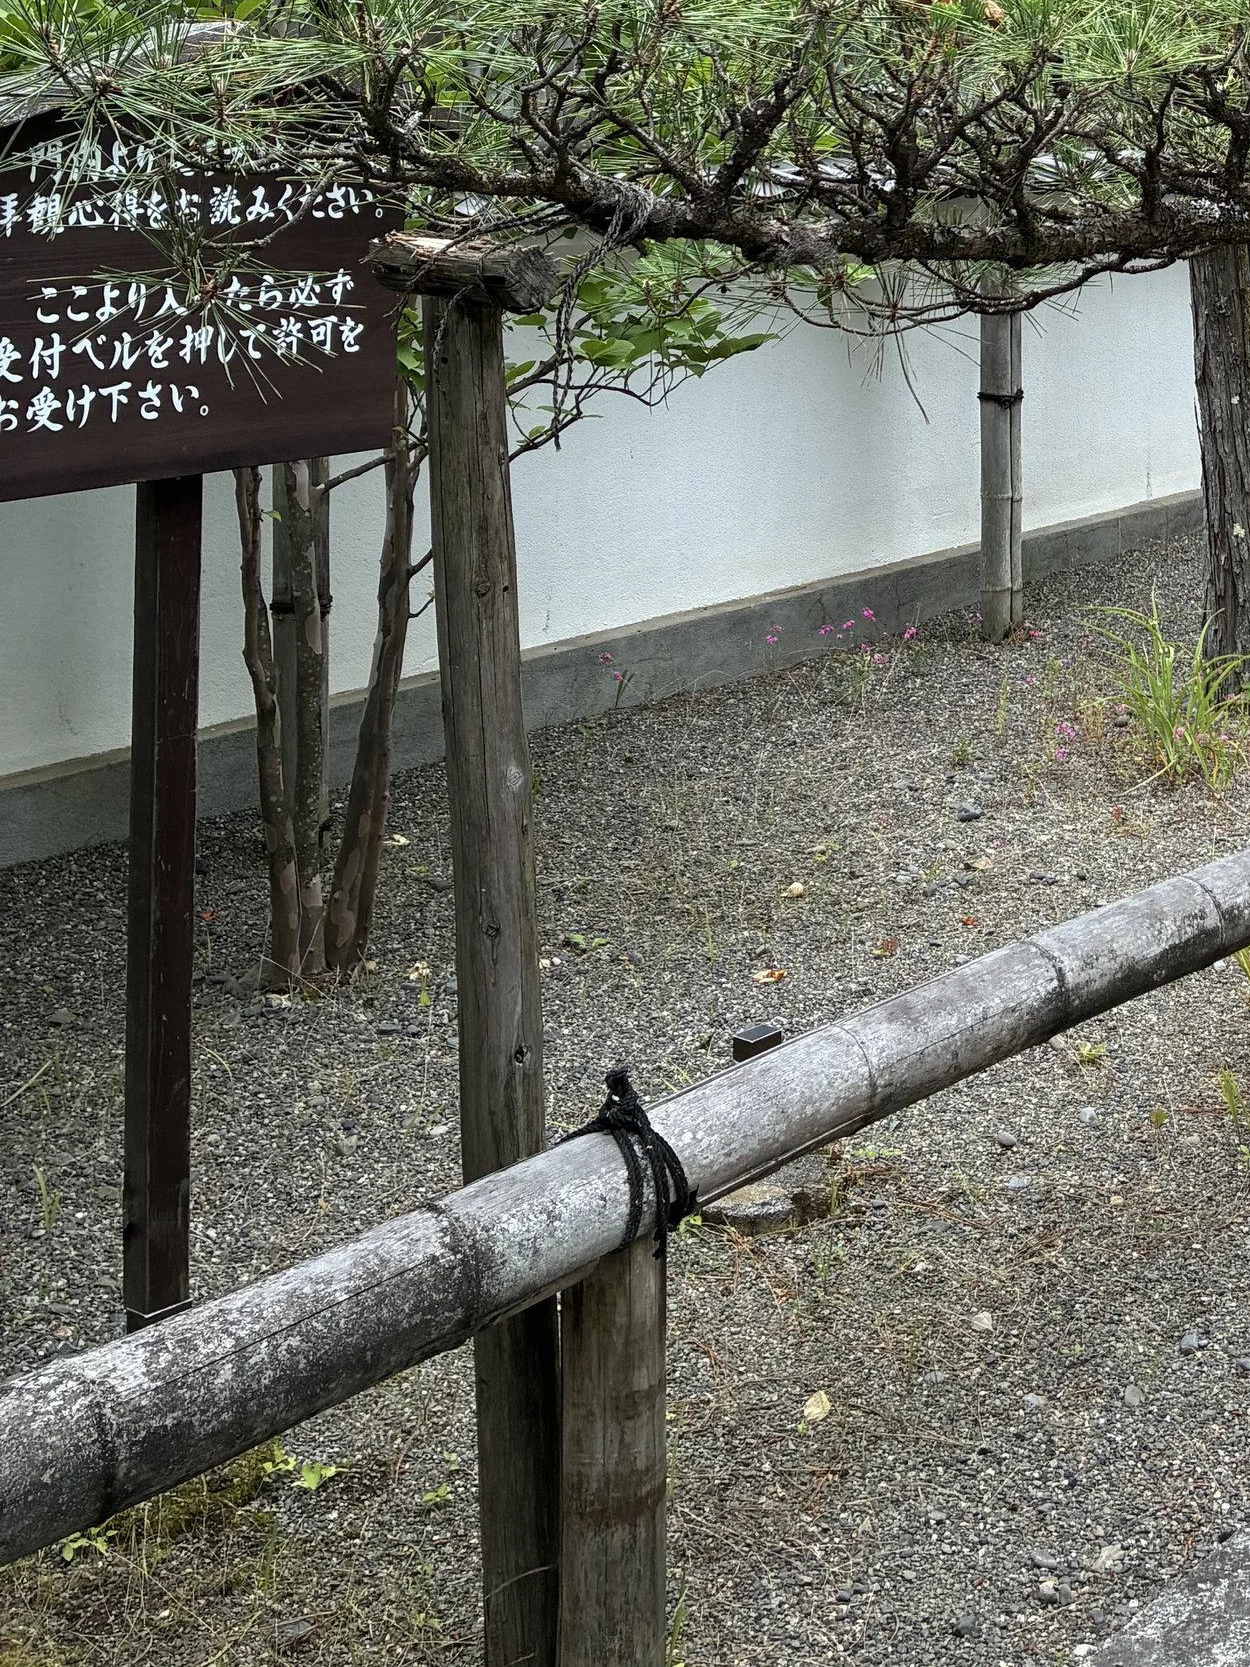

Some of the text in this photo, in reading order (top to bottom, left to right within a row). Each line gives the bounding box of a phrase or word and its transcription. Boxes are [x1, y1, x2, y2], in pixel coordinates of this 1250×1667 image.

[36, 267, 355, 324] ここより入たら必ず
